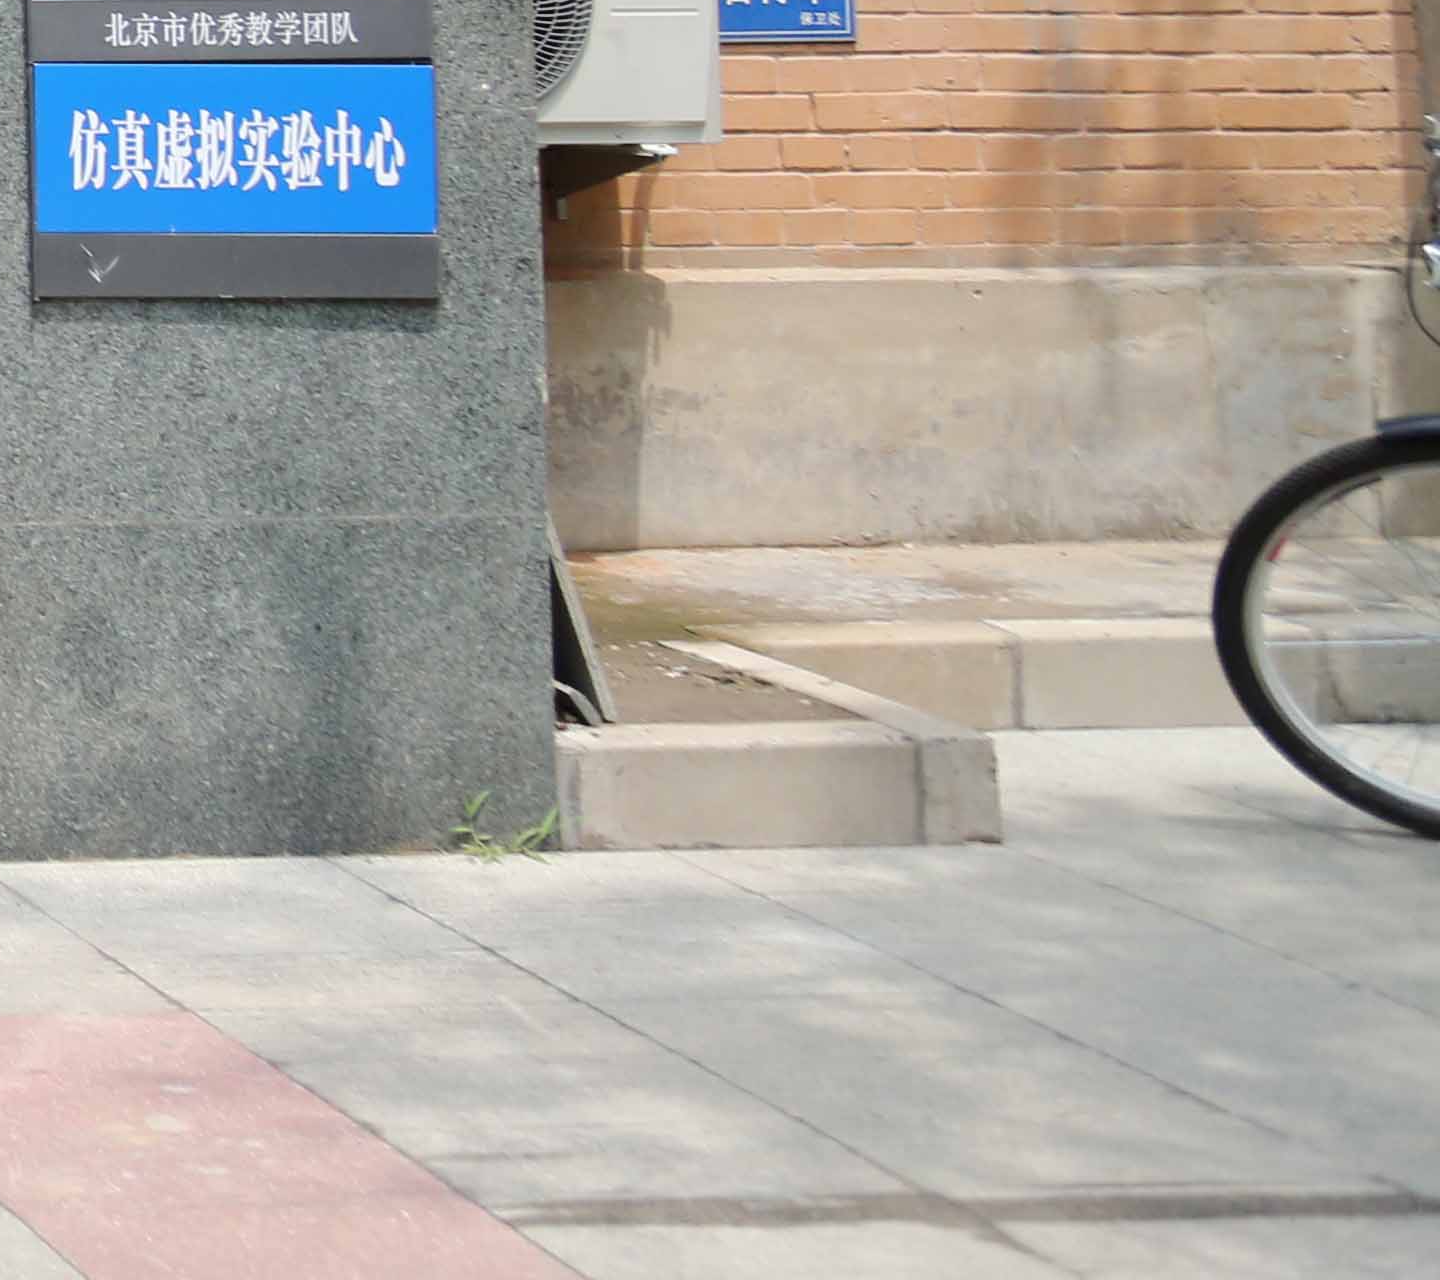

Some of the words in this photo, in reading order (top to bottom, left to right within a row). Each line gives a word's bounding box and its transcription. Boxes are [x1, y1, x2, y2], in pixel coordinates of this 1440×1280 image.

[104, 10, 359, 48] 北京市优秀教学团队
[69, 108, 407, 192] 仿真虚拟实验中心
